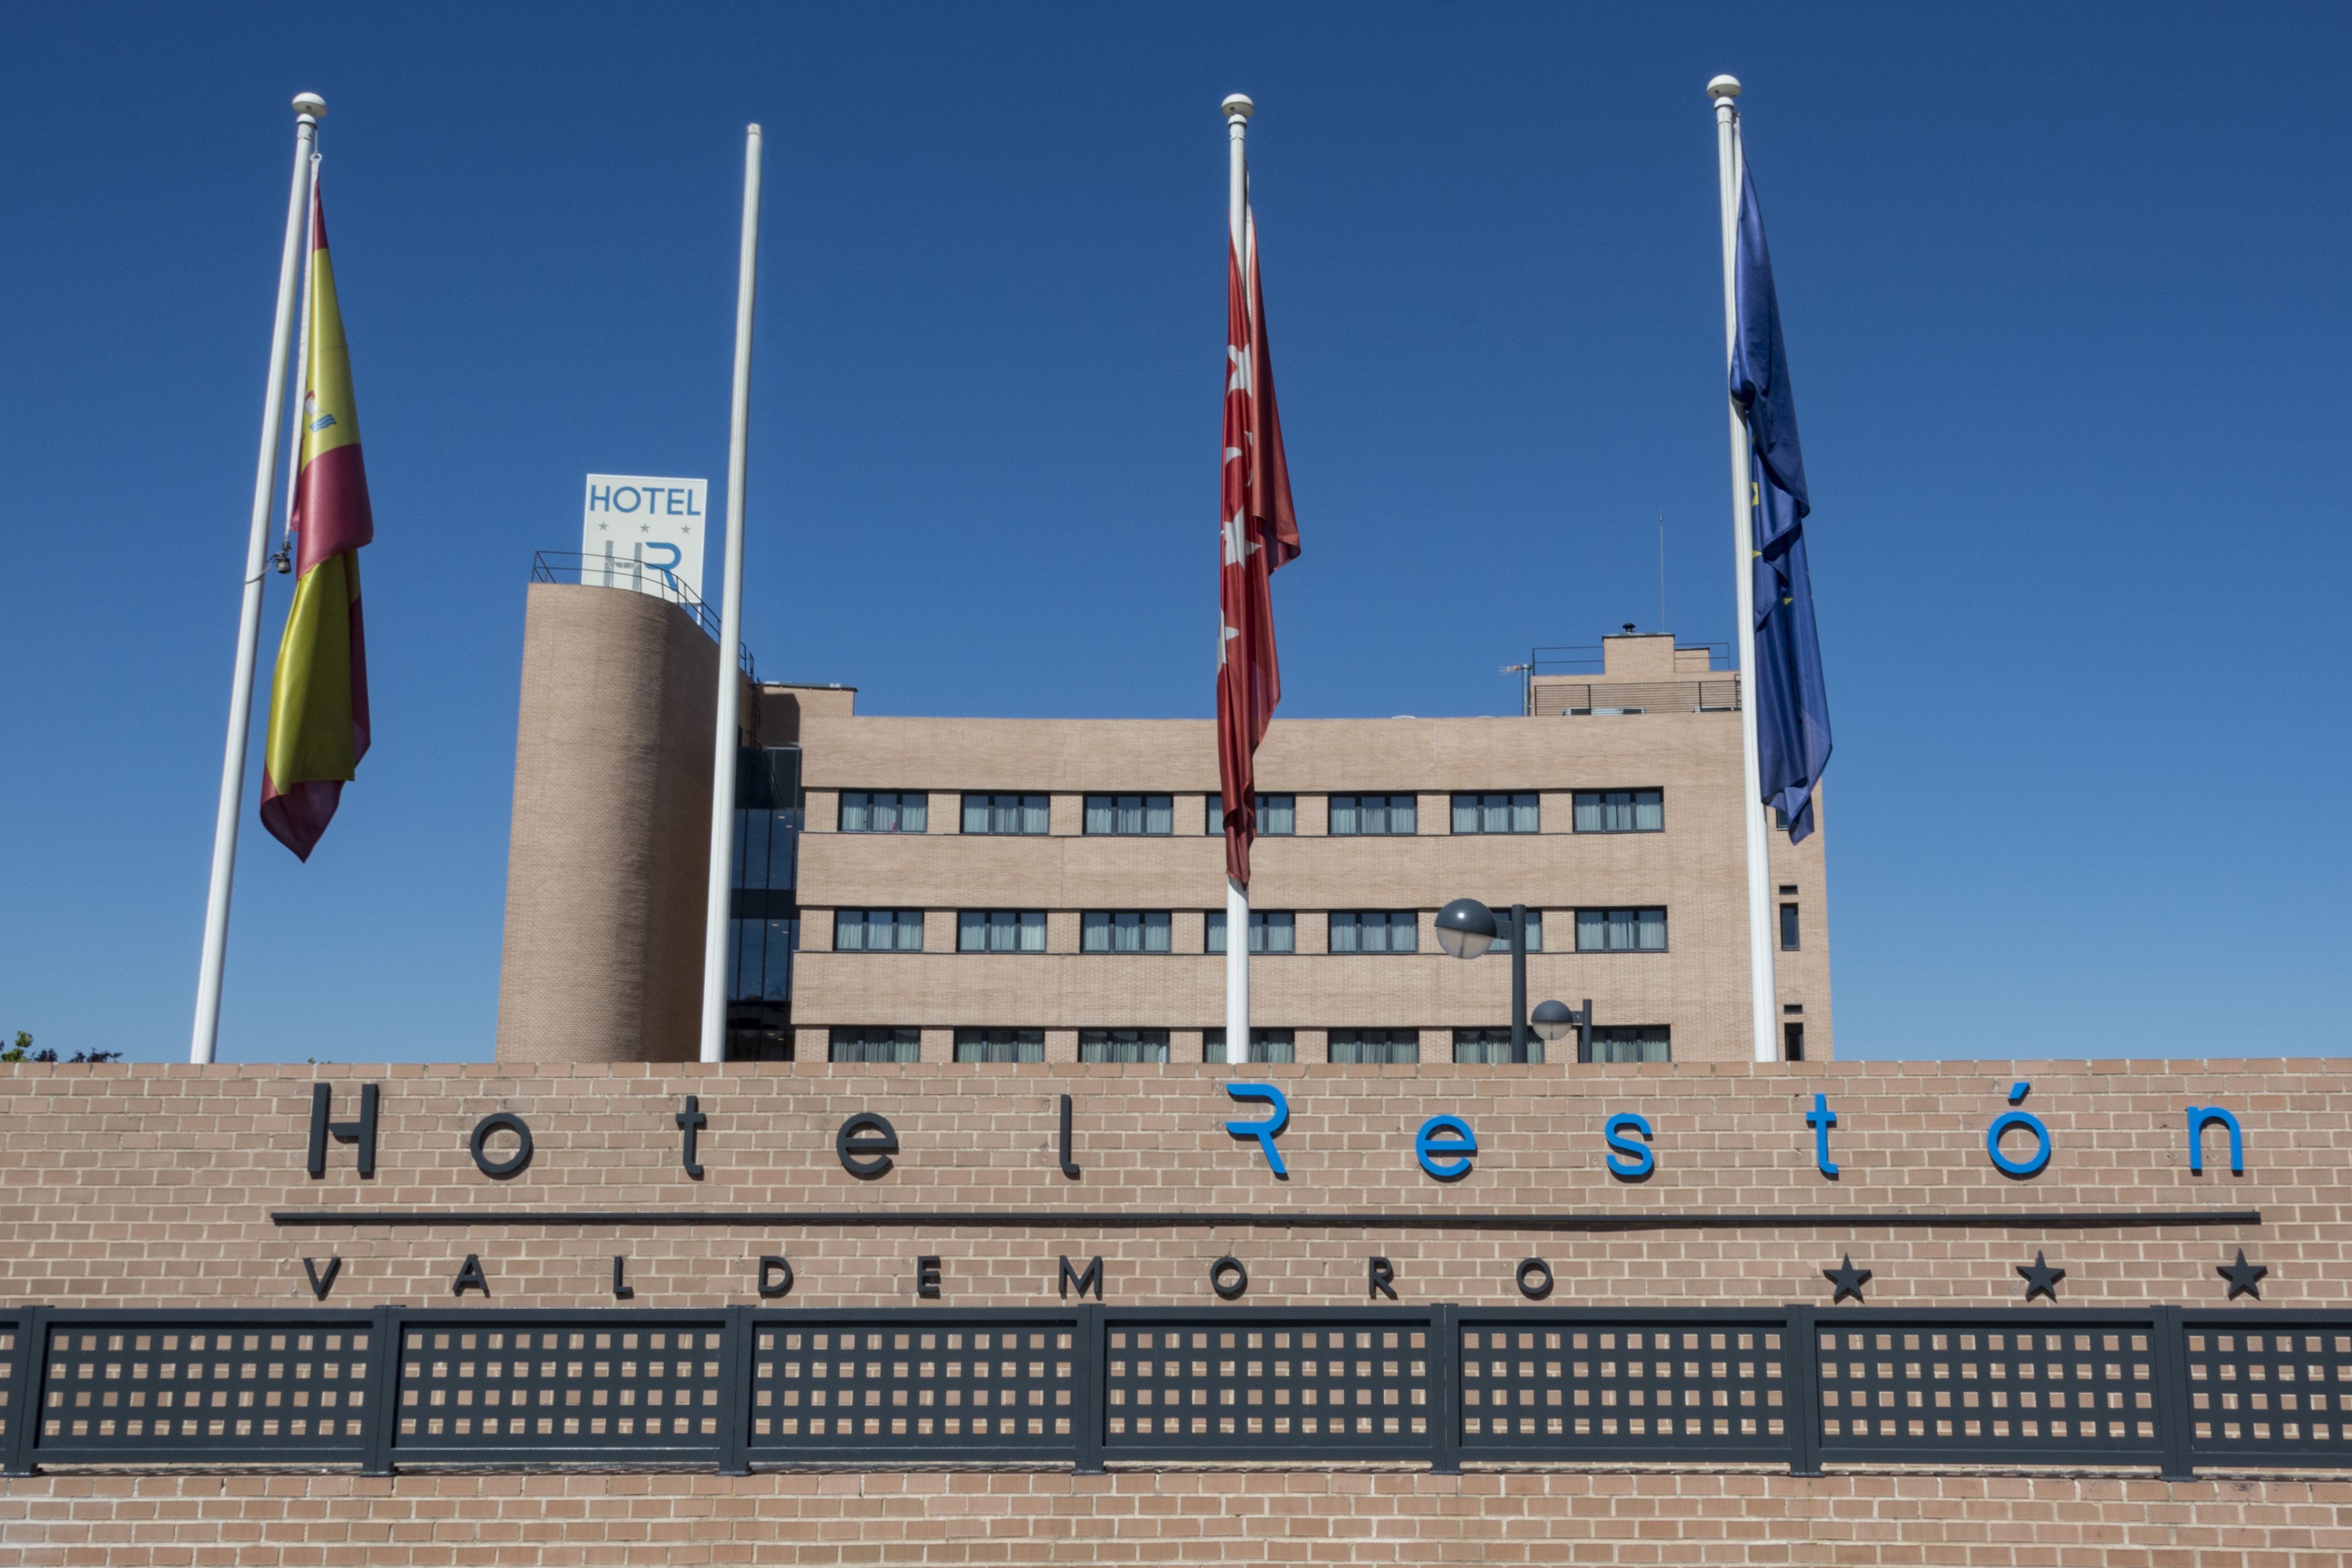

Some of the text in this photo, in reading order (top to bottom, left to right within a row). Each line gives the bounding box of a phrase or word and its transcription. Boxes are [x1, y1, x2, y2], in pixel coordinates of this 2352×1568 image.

[590, 484, 701, 516] HOTEL
[307, 1082, 2244, 1181] Hotel Restón
[304, 1254, 1553, 1300] VALDEMORO
